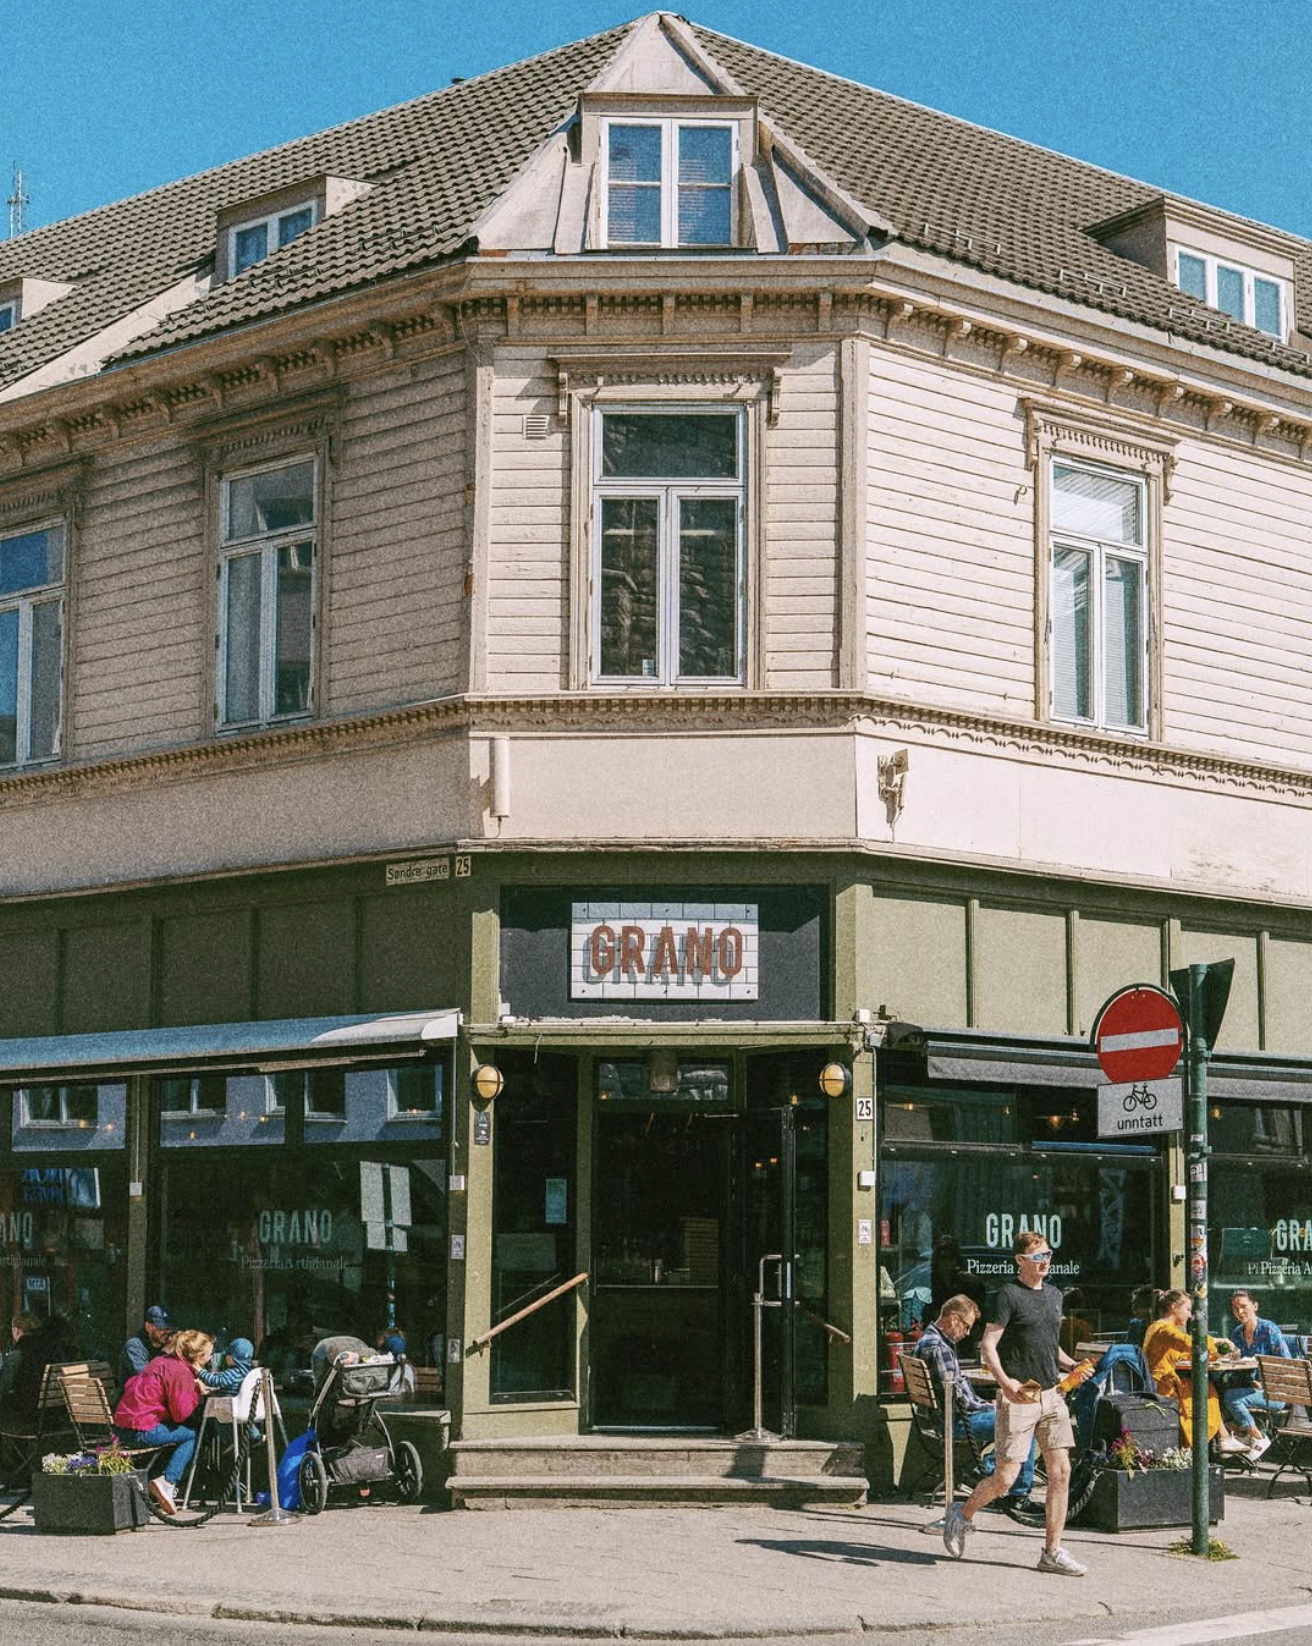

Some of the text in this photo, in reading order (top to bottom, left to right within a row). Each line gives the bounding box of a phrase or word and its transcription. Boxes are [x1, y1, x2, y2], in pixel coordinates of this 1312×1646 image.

[387, 865, 448, 880] Søndre gate
[456, 858, 469, 875] 25
[592, 925, 743, 977] GRANO
[858, 1100, 871, 1117] 25
[1117, 1114, 1163, 1130] unntatt
[259, 1209, 332, 1243] GRANO
[967, 1259, 1014, 1274] Pizzeria
[1260, 1260, 1302, 1275] Pizzeria
